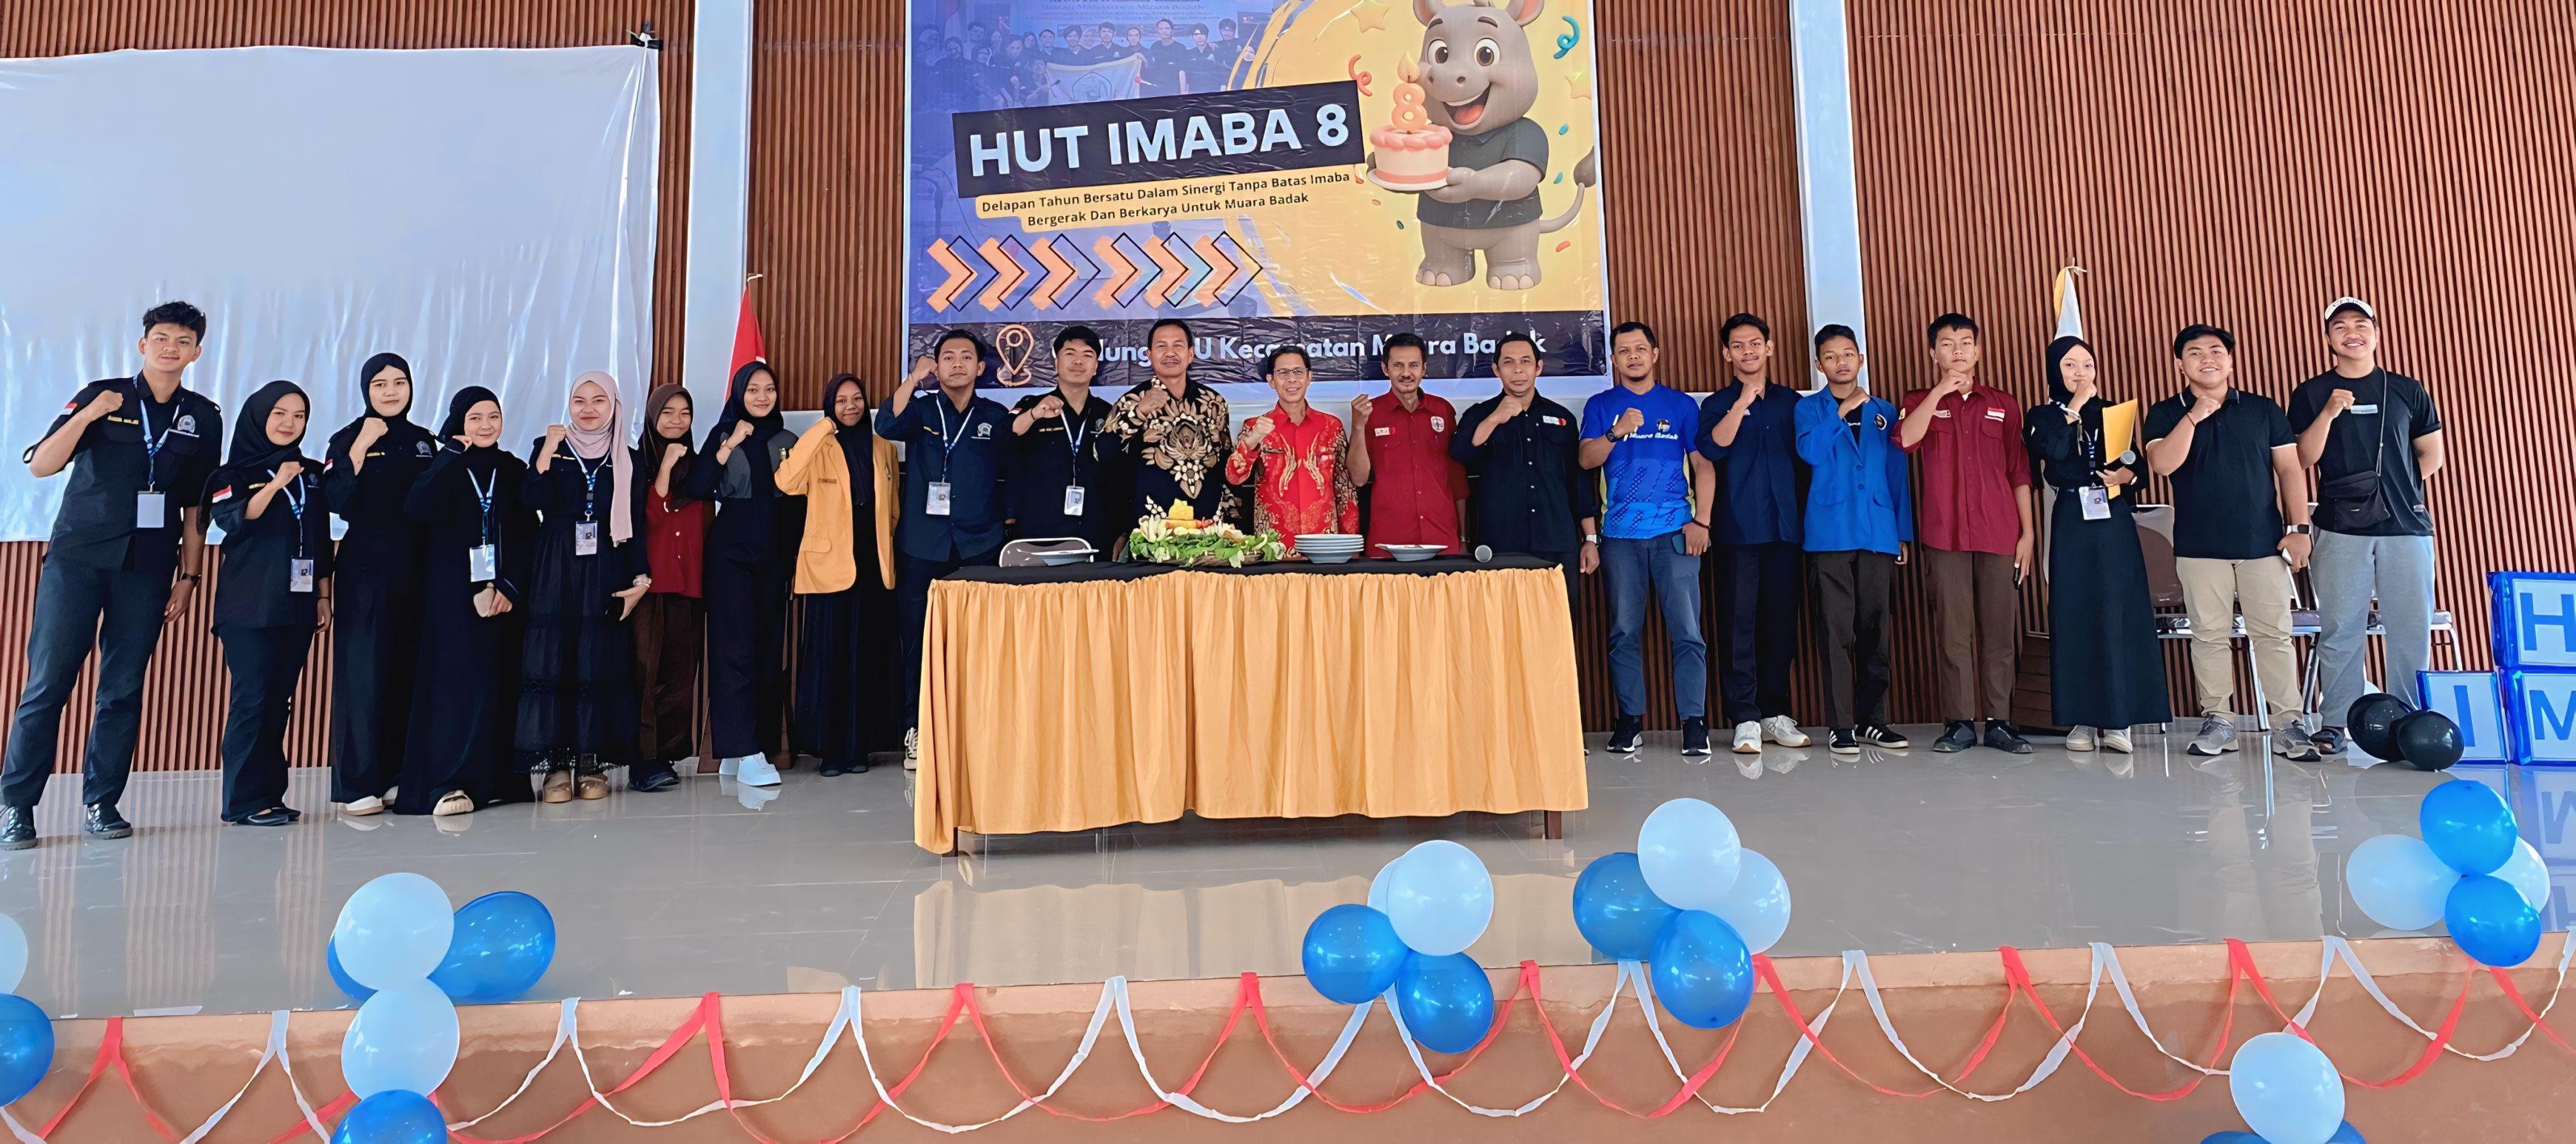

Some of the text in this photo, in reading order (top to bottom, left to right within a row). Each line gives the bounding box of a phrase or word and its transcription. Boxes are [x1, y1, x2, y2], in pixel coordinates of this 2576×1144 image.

[1392, 82, 1427, 132] 8
[970, 104, 1349, 177] HUT IMABA 8
[982, 172, 1350, 212] Delapan Tahun Bersatu Dalam Sinergi Tanpa Batas Imaba
[1027, 192, 1309, 226] Bergerak Dan Berkarya Untuk Muara Badak
[1219, 337, 1366, 360] Kecatan
[1372, 334, 1456, 356] Mra
[1463, 329, 1547, 354] Bak
[2520, 593, 2576, 652] H
